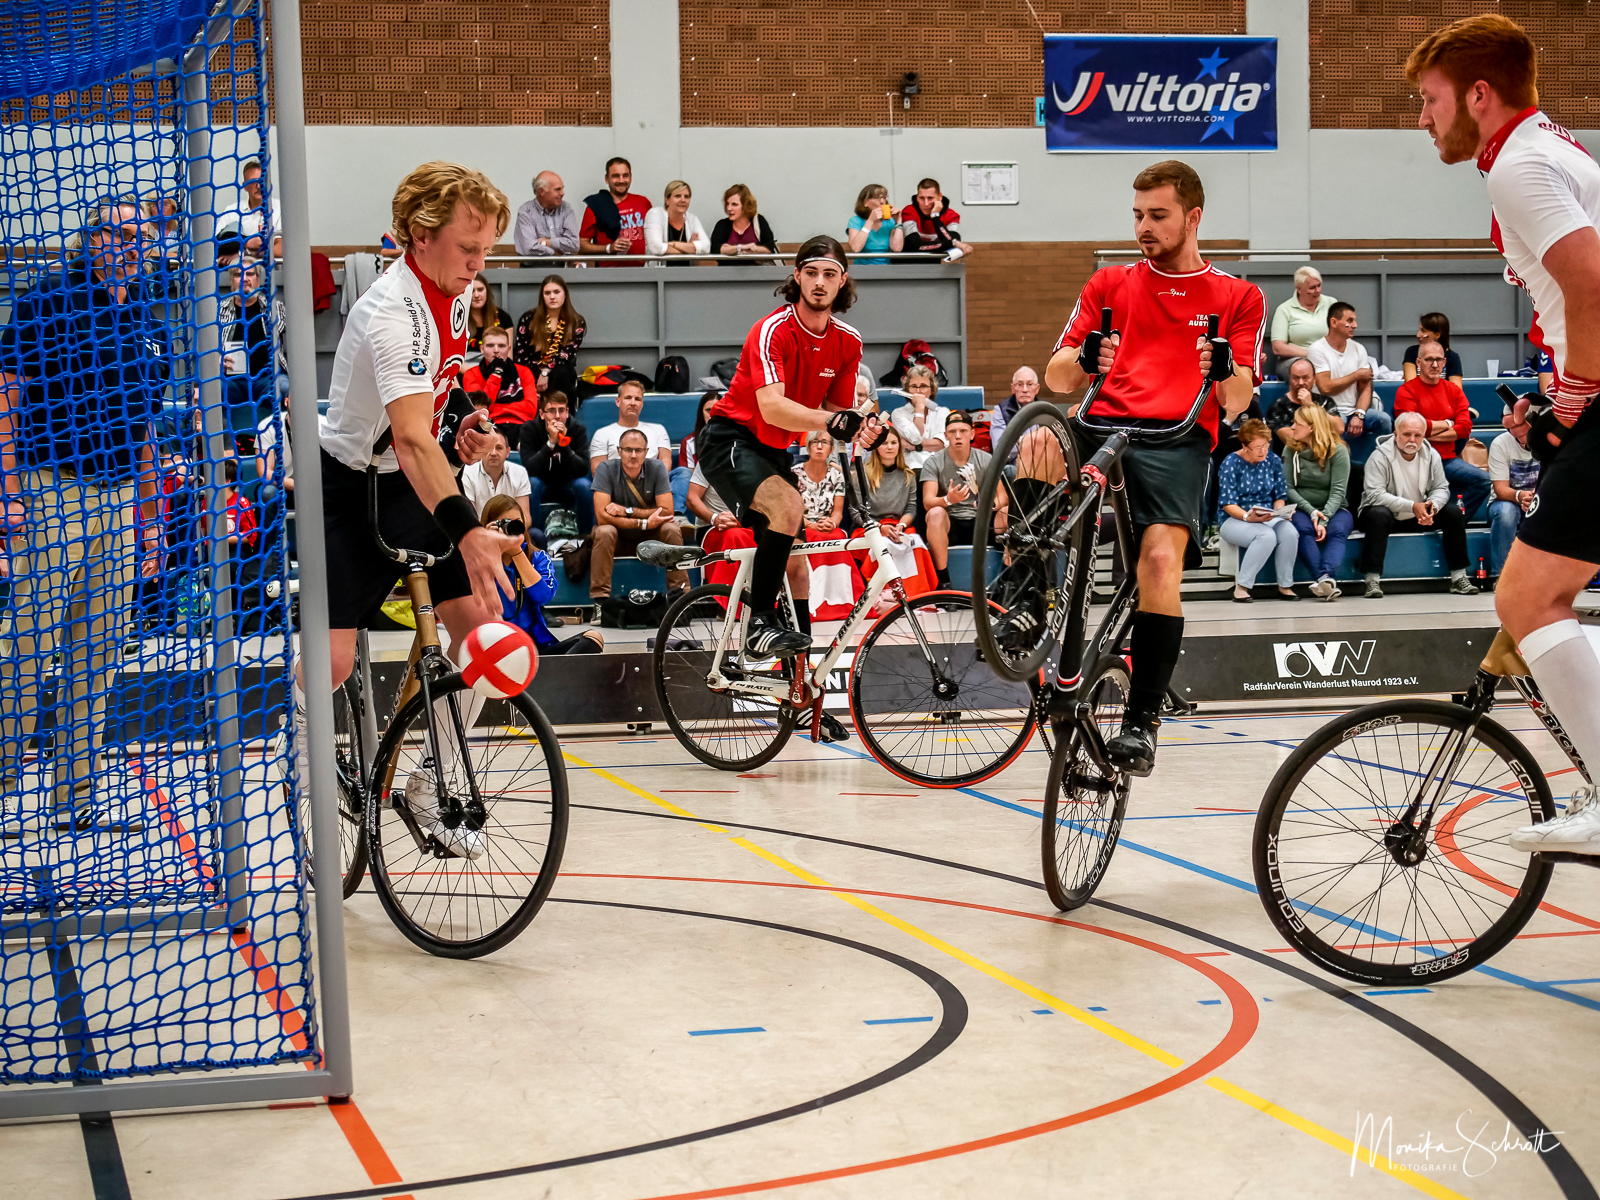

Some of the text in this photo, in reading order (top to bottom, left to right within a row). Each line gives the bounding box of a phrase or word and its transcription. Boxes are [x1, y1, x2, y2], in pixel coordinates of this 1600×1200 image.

[1127, 115, 1225, 123] WWW.VITTORIA.COM
[403, 296, 414, 309] AG
[1243, 676, 1420, 692] RadfahrVerein Wanderlust Naurod 1923 e.V.
[1267, 833, 1305, 933] EQUINOX
